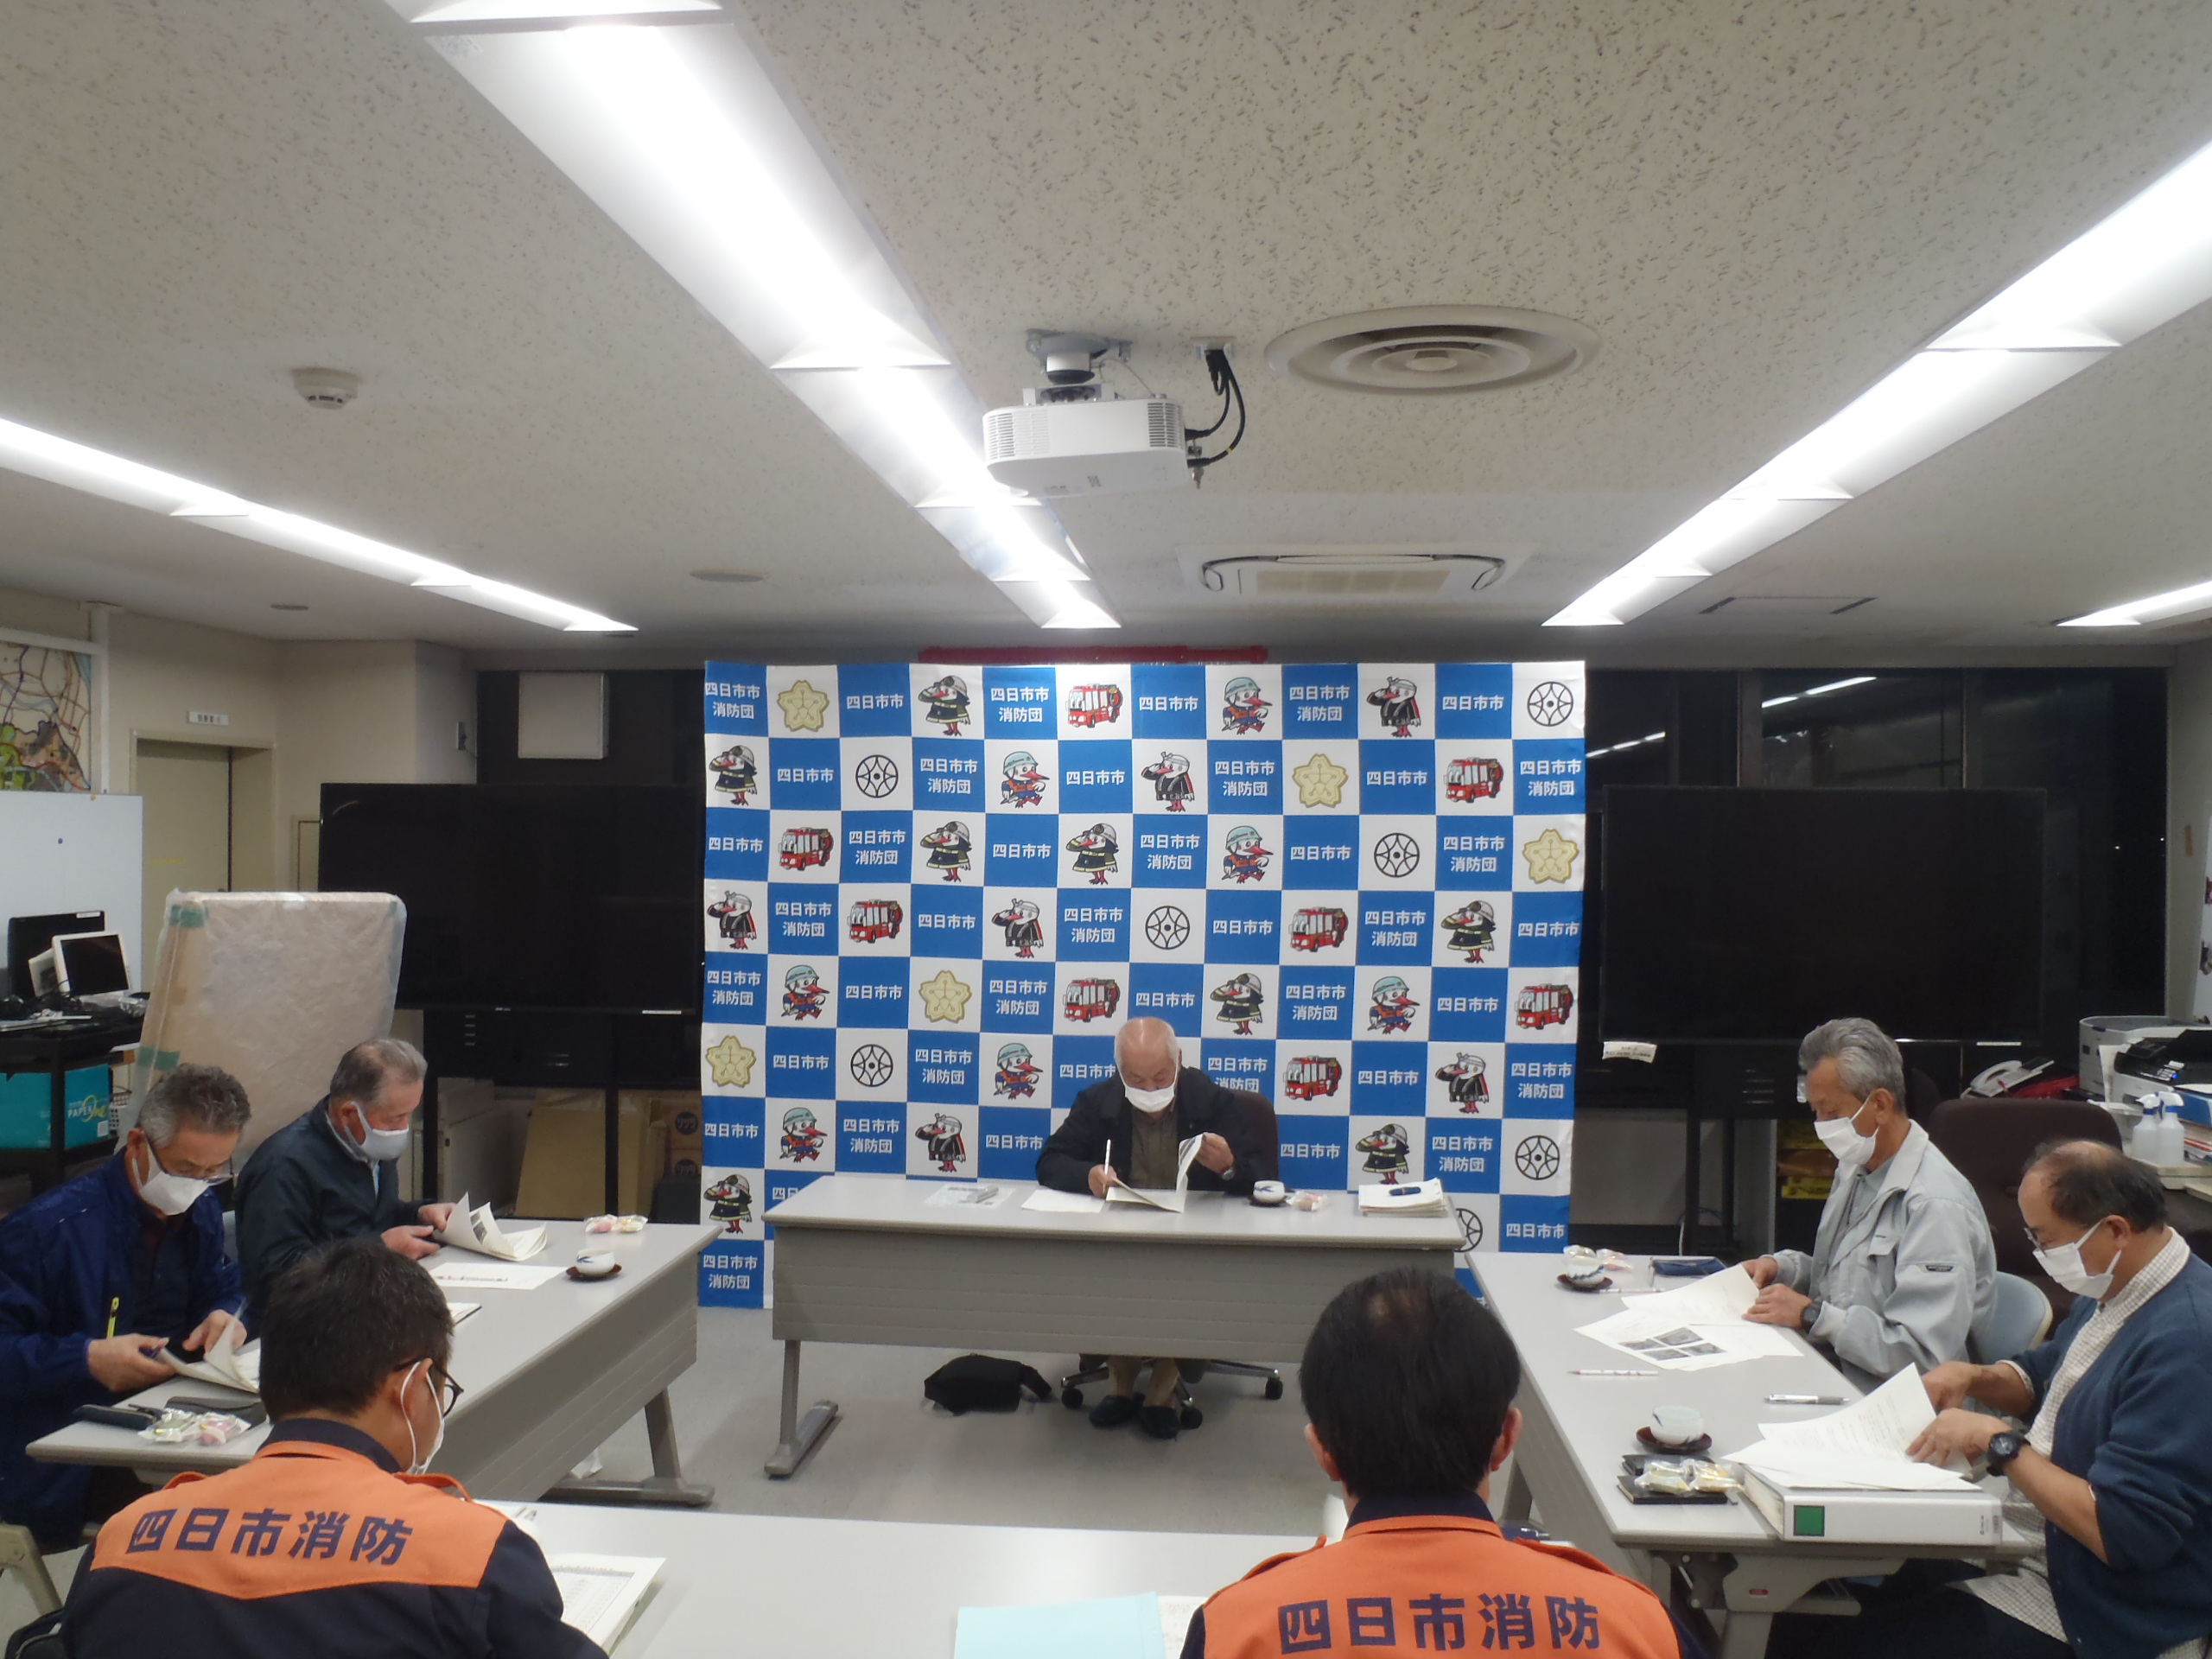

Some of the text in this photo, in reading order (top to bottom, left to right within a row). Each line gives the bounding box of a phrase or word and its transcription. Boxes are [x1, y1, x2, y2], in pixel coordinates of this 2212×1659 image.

[705, 682, 760, 699] 四日市市
[991, 687, 1049, 702] 四日市市
[1290, 685, 1350, 700] 四日市市
[847, 694, 903, 709] 四日市市
[1140, 696, 1198, 711] 四日市市
[1443, 695, 1504, 710] 四日市市
[713, 702, 753, 719] 消防団
[999, 707, 1042, 722] 消防団
[1298, 706, 1342, 721] 消防団
[921, 759, 977, 773] 四日市市
[1216, 760, 1274, 775] 四日市市
[1521, 759, 1581, 775] 四日市市
[778, 768, 834, 782] 四日市市
[1067, 770, 1125, 785] 四日市市
[1367, 771, 1427, 785] 四日市市
[928, 778, 970, 794] 消防団
[1223, 781, 1268, 796] 消防団
[1529, 780, 1574, 796] 消防団
[849, 830, 906, 844] 四日市市
[1141, 835, 1200, 849] 四日市市
[1444, 836, 1505, 851] 四日市市
[709, 837, 763, 853] 四日市市
[994, 843, 1051, 858] 四日市市
[856, 850, 898, 864] 消防団
[1291, 846, 1351, 861] 四日市市
[1147, 855, 1192, 869] 消防団
[1451, 857, 1497, 872] 消防団
[776, 902, 832, 917] 四日市市
[1065, 907, 1122, 922] 四日市市
[918, 914, 976, 930] 四日市市
[1365, 911, 1426, 925] 四日市市
[783, 922, 824, 937] 消防団
[1213, 919, 1273, 935] 四日市市
[1518, 922, 1580, 937] 四日市市
[1071, 928, 1115, 943] 消防団
[1372, 931, 1417, 946] 消防団
[708, 971, 760, 986] 四日市市
[846, 985, 902, 1000] 四日市市
[990, 980, 1047, 995] 四日市市
[1286, 985, 1346, 1000] 四日市市
[713, 990, 753, 1006] 消防団
[1136, 993, 1195, 1007] 四日市市
[1438, 997, 1498, 1012] 四日市市
[996, 1000, 1039, 1015] 消防団
[1293, 1006, 1338, 1020] 消防団
[773, 1055, 829, 1070] 四日市市
[916, 1049, 972, 1065] 四日市市
[1059, 1064, 1116, 1078] 四日市市
[1208, 1058, 1268, 1072] 四日市市
[1511, 1063, 1572, 1077] 四日市市
[923, 1069, 964, 1084] 消防団
[1358, 1070, 1419, 1085] 四日市市
[1518, 1084, 1564, 1098] 消防団
[705, 1123, 759, 1138] 四日市市
[844, 1119, 899, 1134] 四日市市
[851, 1138, 892, 1154] 消防団
[986, 1135, 1043, 1150] 四日市市
[1433, 1136, 1493, 1151] 四日市市
[1281, 1144, 1340, 1159] 四日市市
[1440, 1157, 1484, 1173] 消防団
[1507, 1224, 1564, 1238] 四日市市
[703, 1255, 757, 1269] 四日市市
[709, 1274, 749, 1289] 消防団
[125, 1508, 413, 1566] 四日市消防
[1278, 1593, 1600, 1654] 四日市消防
